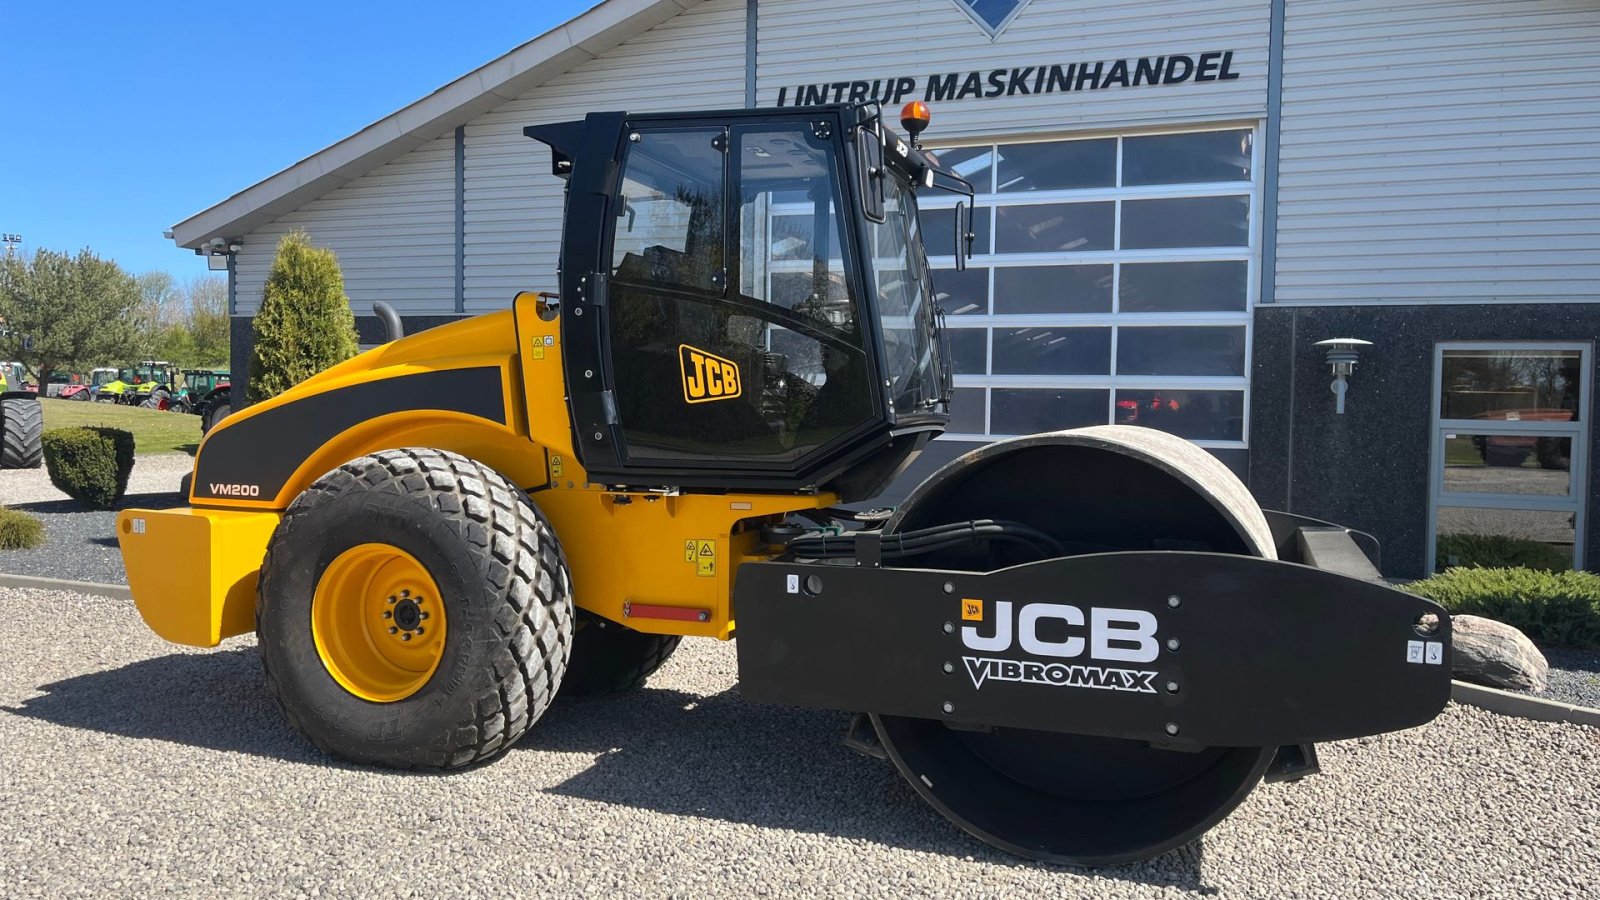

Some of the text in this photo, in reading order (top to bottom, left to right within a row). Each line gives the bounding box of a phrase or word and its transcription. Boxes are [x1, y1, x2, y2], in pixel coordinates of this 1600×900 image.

[924, 51, 1240, 102] MASKINHANDEL
[687, 352, 737, 398] JCB
[210, 483, 260, 497] VM200
[961, 600, 1160, 663] JCB
[961, 656, 1159, 694] VIBROMAX
